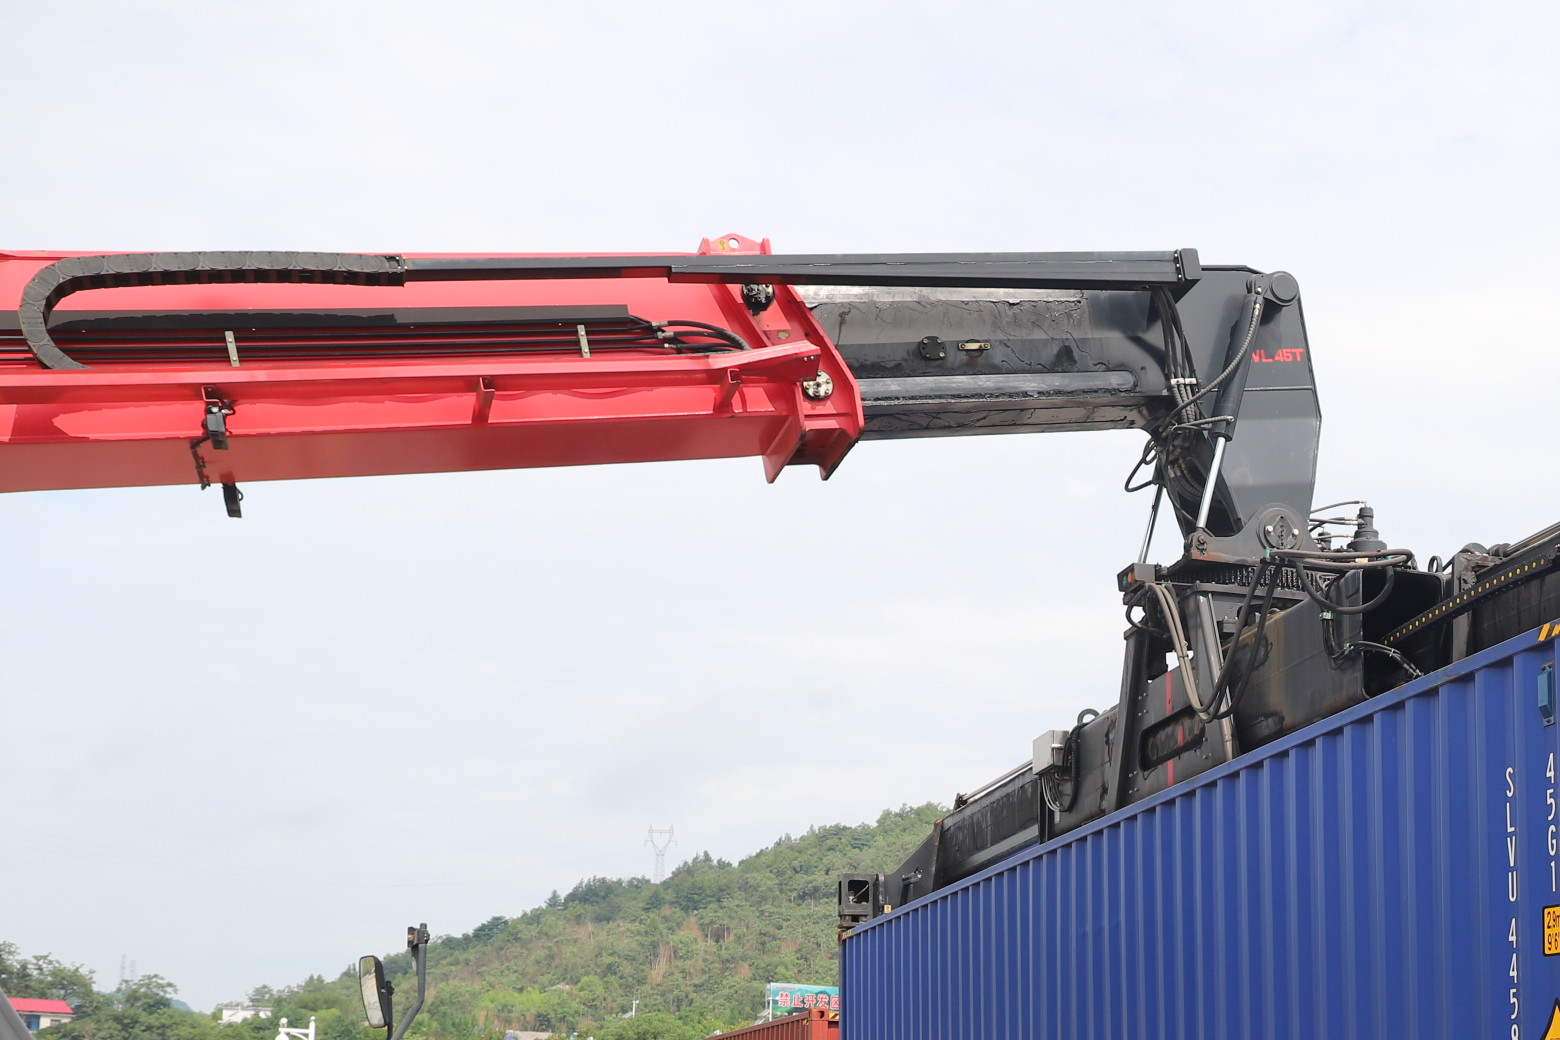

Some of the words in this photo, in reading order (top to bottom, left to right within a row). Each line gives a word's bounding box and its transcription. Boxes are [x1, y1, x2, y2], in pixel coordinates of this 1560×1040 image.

[1274, 348, 1304, 362] 45T
[1505, 766, 1517, 902] SLVU
[1546, 752, 1557, 892] 45G1
